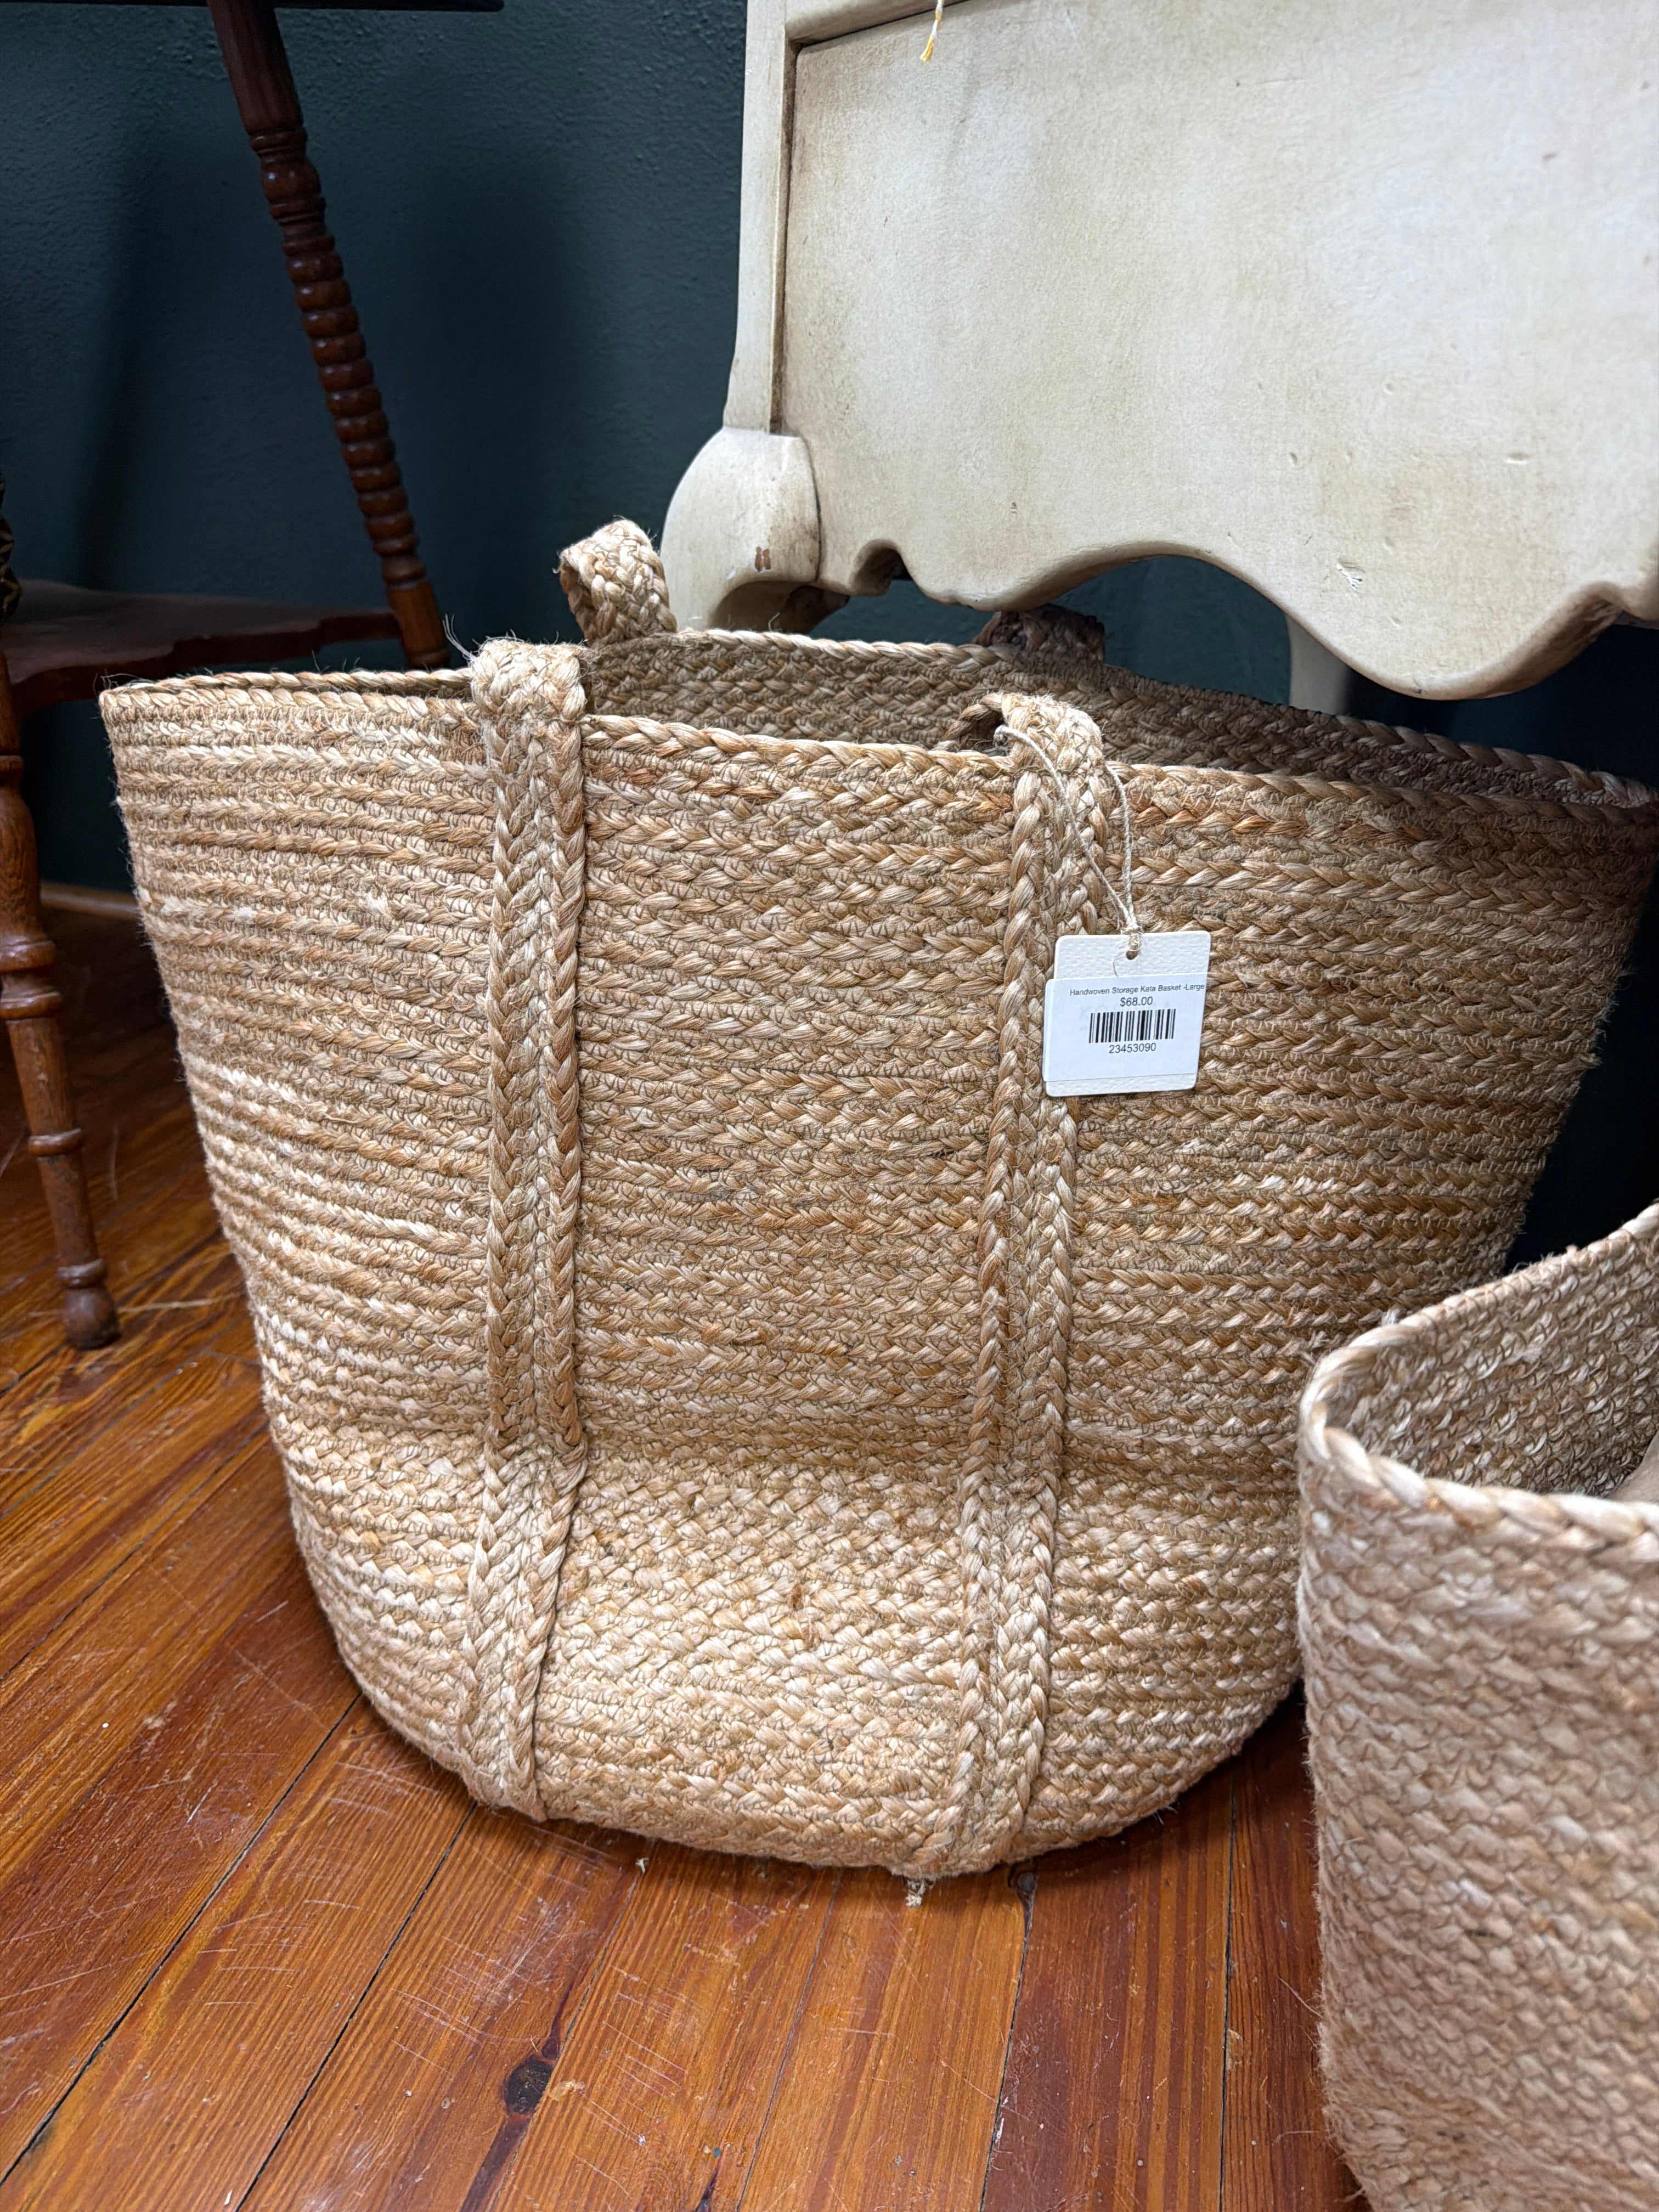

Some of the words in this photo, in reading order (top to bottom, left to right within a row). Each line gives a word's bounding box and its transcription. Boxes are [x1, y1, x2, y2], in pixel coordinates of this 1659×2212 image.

[1111, 987, 1138, 995] Storage
[1120, 996, 1153, 1007] $68.00
[1109, 1043, 1156, 1054] 23453090
